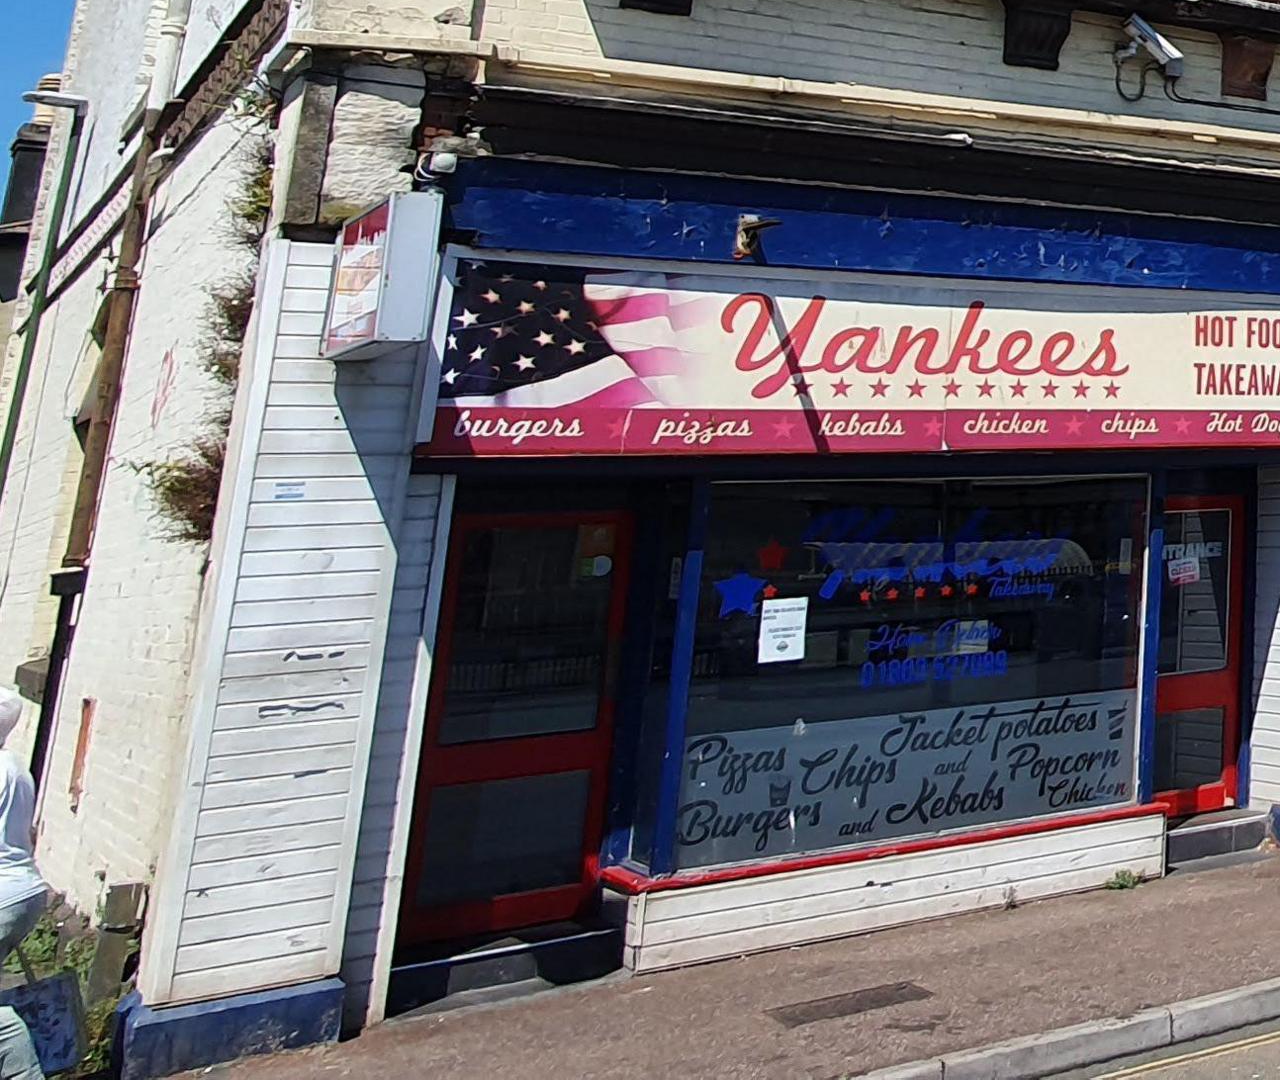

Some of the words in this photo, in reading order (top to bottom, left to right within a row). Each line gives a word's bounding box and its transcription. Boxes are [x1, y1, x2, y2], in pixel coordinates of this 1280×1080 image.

[721, 292, 1129, 399] Yankees
[1194, 316, 1238, 348] HOT
[454, 410, 584, 444] burgers
[652, 412, 753, 445] pizzas
[819, 411, 906, 436] kebabs
[963, 409, 1048, 435] chicken
[1101, 411, 1159, 439] chips
[1206, 412, 1243, 434] Hot
[880, 705, 996, 757] Jacket
[991, 698, 1100, 761] potatoes
[687, 735, 786, 795] Pizzas
[800, 743, 898, 809] Chips
[934, 750, 972, 775] and
[1006, 742, 1121, 797] Popcorn
[677, 799, 822, 852] Burgers
[838, 809, 879, 837] and
[886, 771, 1005, 824] Kebabs
